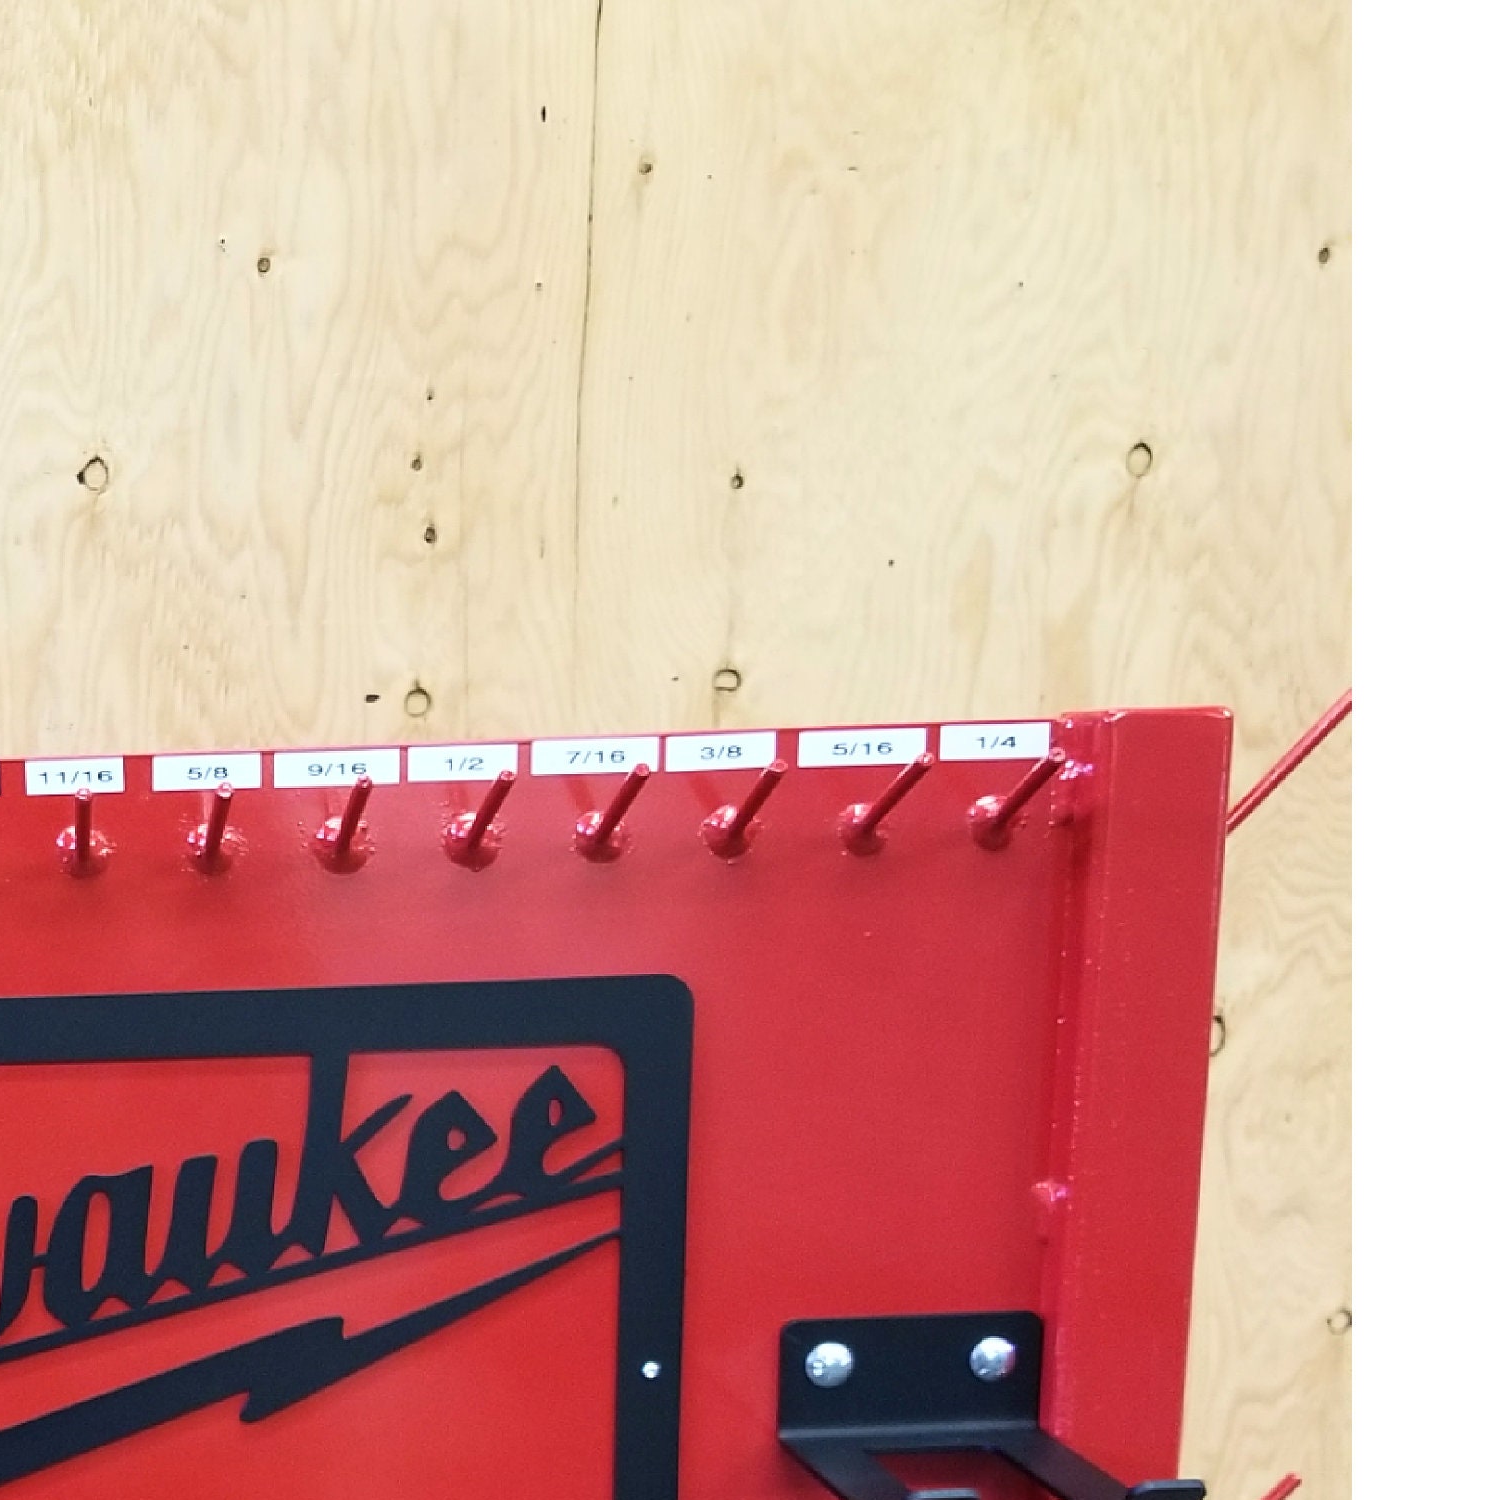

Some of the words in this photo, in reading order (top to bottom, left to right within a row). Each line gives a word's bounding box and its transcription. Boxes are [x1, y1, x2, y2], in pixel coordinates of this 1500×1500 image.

[831, 741, 894, 756] 5/16
[975, 735, 1017, 749] 1/4
[565, 749, 626, 764] 7/16
[699, 744, 743, 760] 3/8
[306, 761, 368, 778] 9/16
[444, 756, 485, 772] 1/2
[37, 769, 114, 785] 11/16
[187, 766, 229, 780] 5/8
